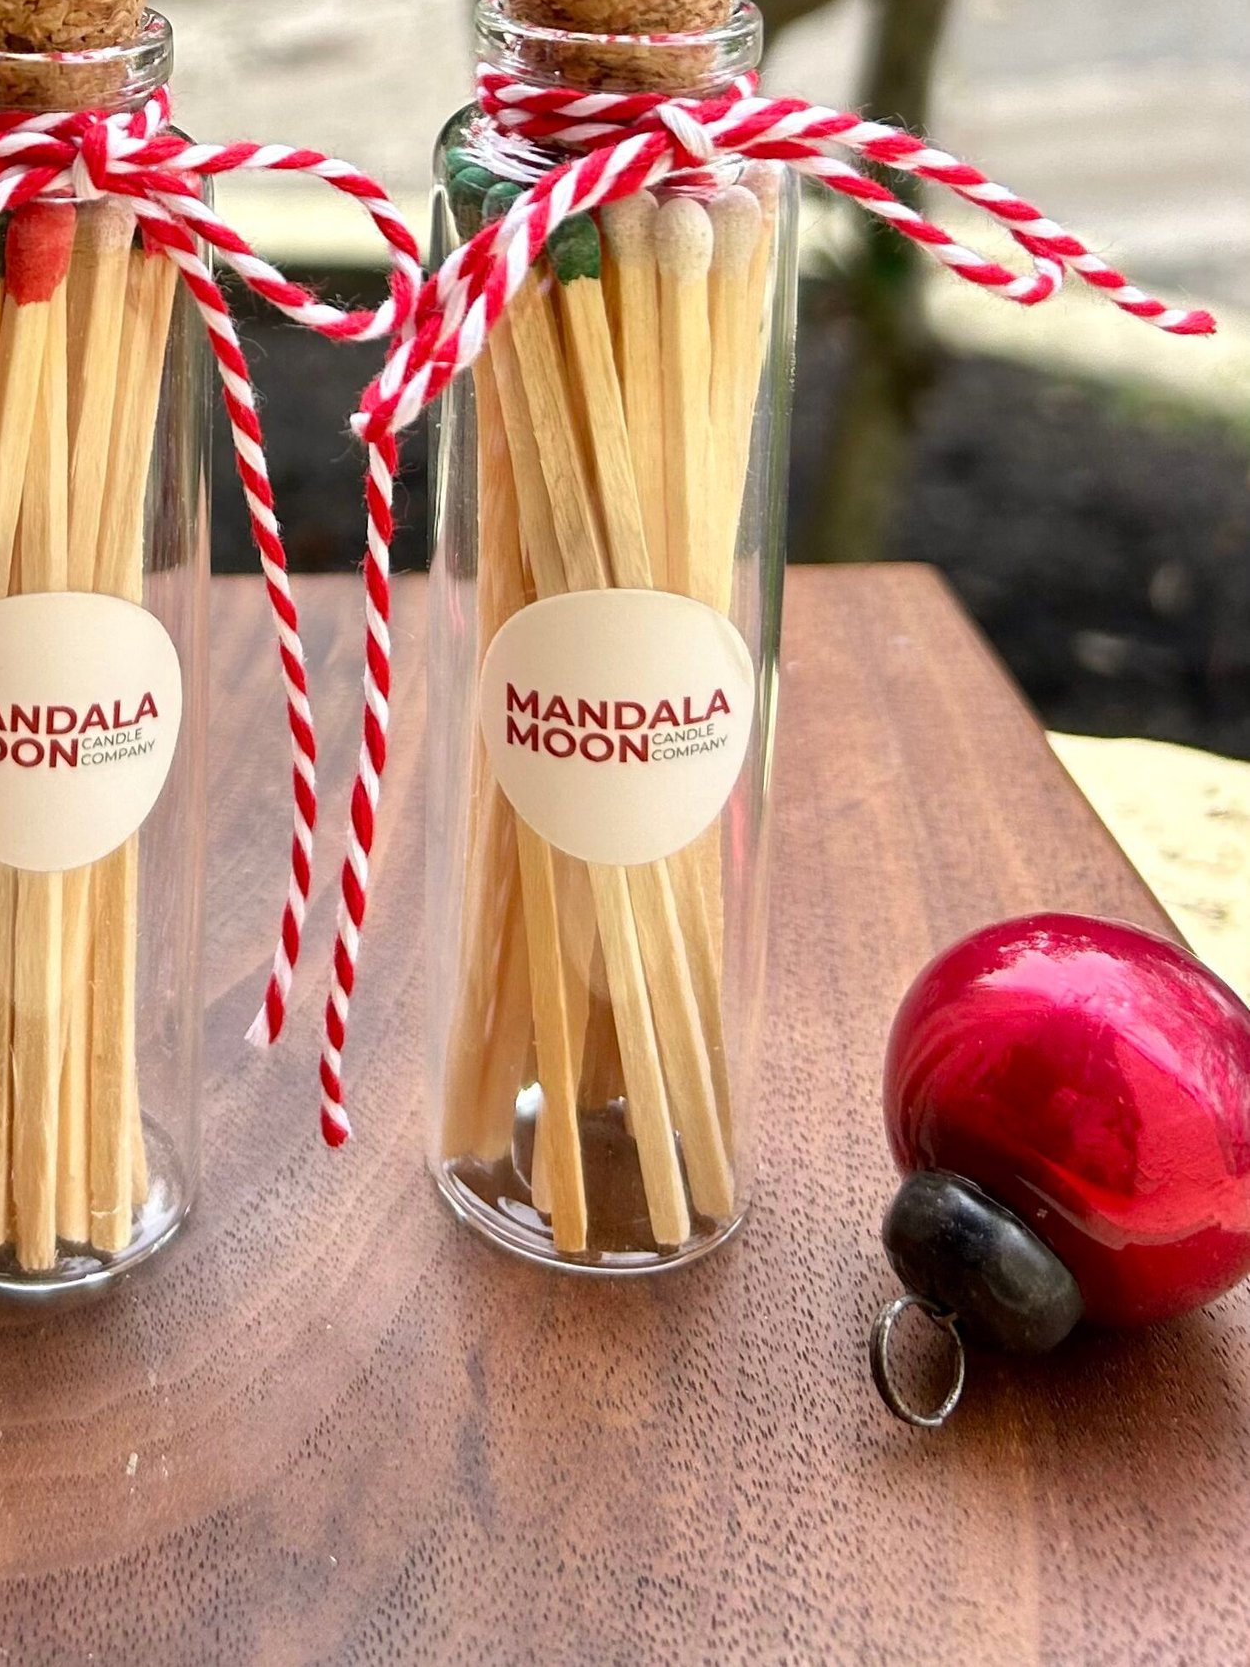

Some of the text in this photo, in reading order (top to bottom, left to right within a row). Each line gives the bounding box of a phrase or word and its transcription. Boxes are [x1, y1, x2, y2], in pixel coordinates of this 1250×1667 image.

[506, 682, 731, 730] MANDALA
[81, 727, 143, 750] CANDLE
[506, 714, 648, 763] MOON
[651, 723, 715, 745] CANDLE
[80, 739, 156, 766] COMPANY
[651, 735, 728, 762] COMPANY
